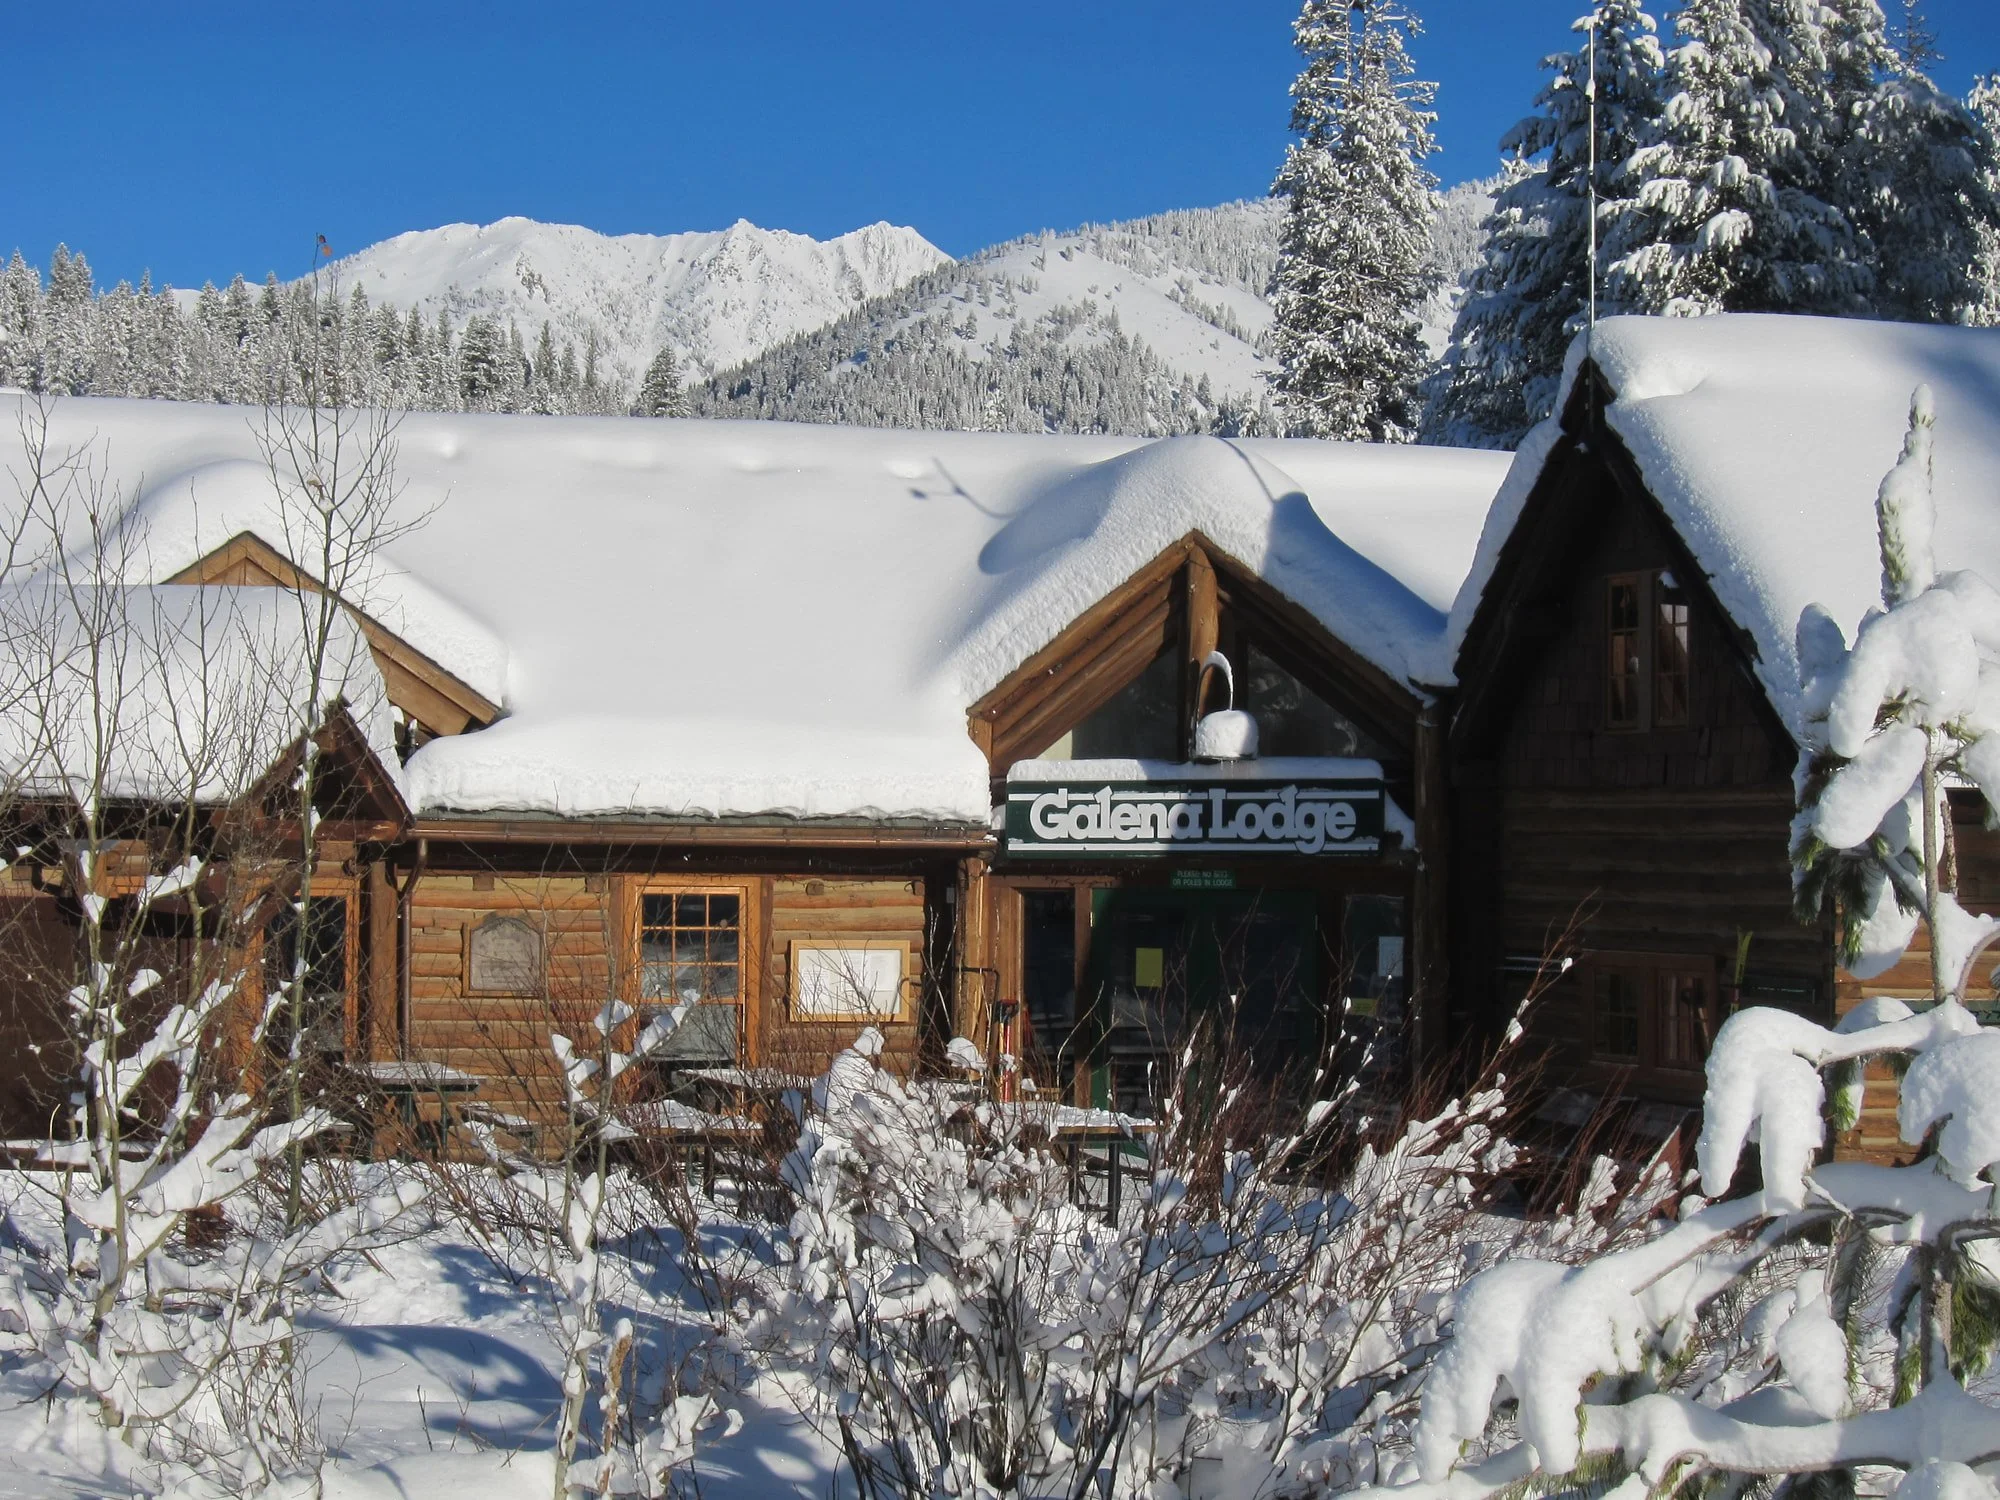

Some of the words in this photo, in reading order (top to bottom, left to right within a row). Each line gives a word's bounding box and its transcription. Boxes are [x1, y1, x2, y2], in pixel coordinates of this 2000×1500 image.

[1030, 785, 1203, 840] Galena
[1208, 784, 1357, 854] Lodge
[1172, 878, 1181, 886] OR
[1183, 878, 1202, 886] POLES
[1204, 878, 1211, 886] IN
[1212, 878, 1233, 887] LODGE
